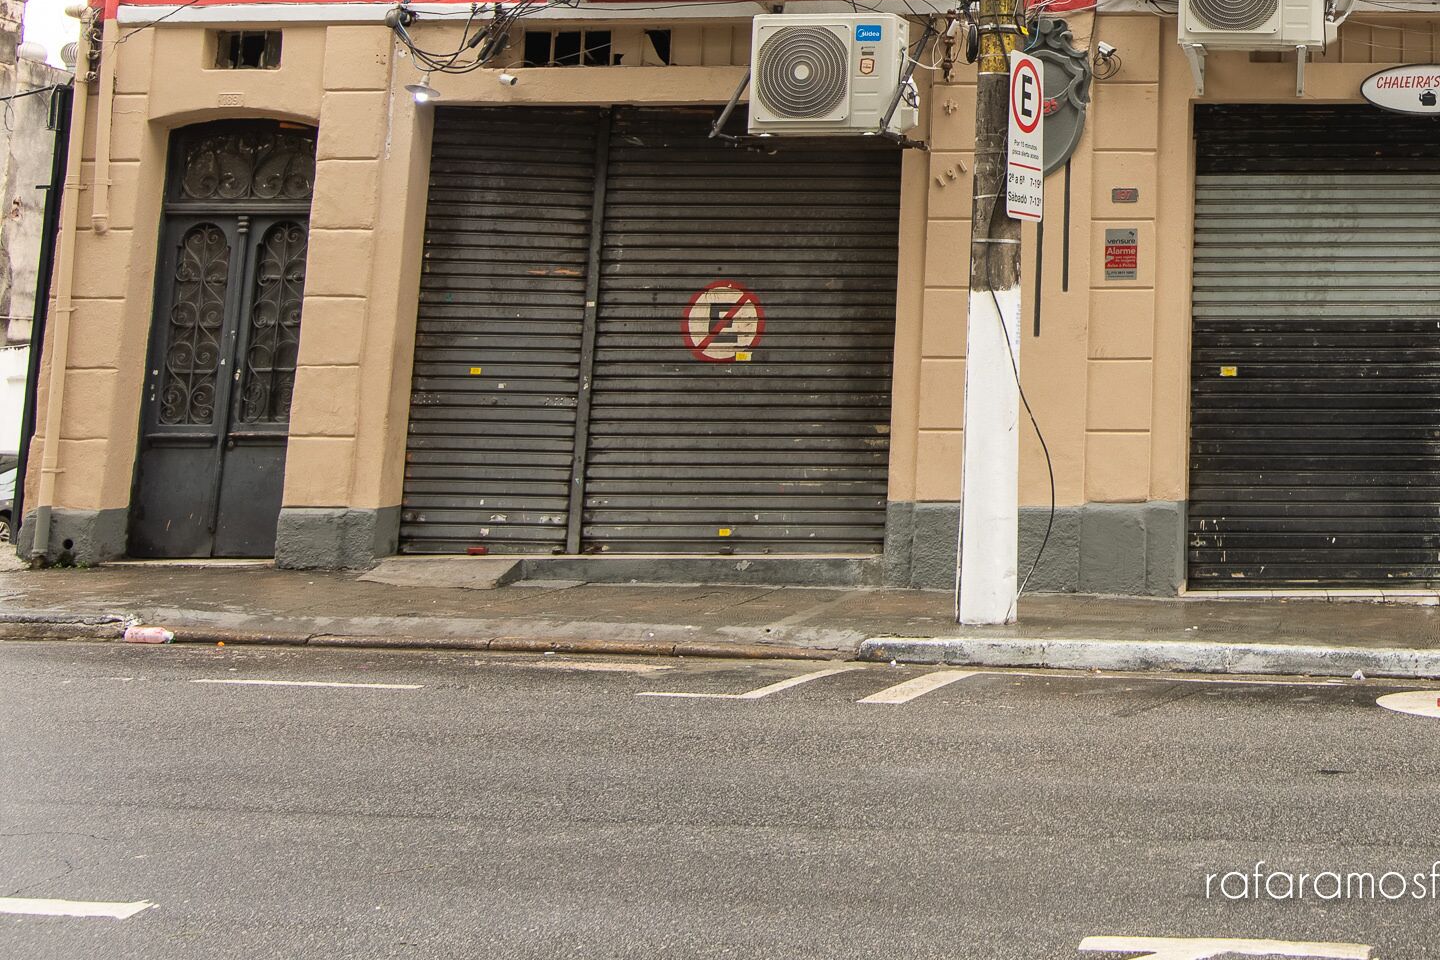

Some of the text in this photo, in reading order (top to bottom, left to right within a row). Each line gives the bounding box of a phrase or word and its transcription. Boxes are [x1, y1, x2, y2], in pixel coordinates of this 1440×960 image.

[1376, 75, 1440, 89] CHALEIRA'S
[1021, 73, 1033, 119] E
[936, 159, 967, 187] 191
[1106, 247, 1136, 255] Alarme
